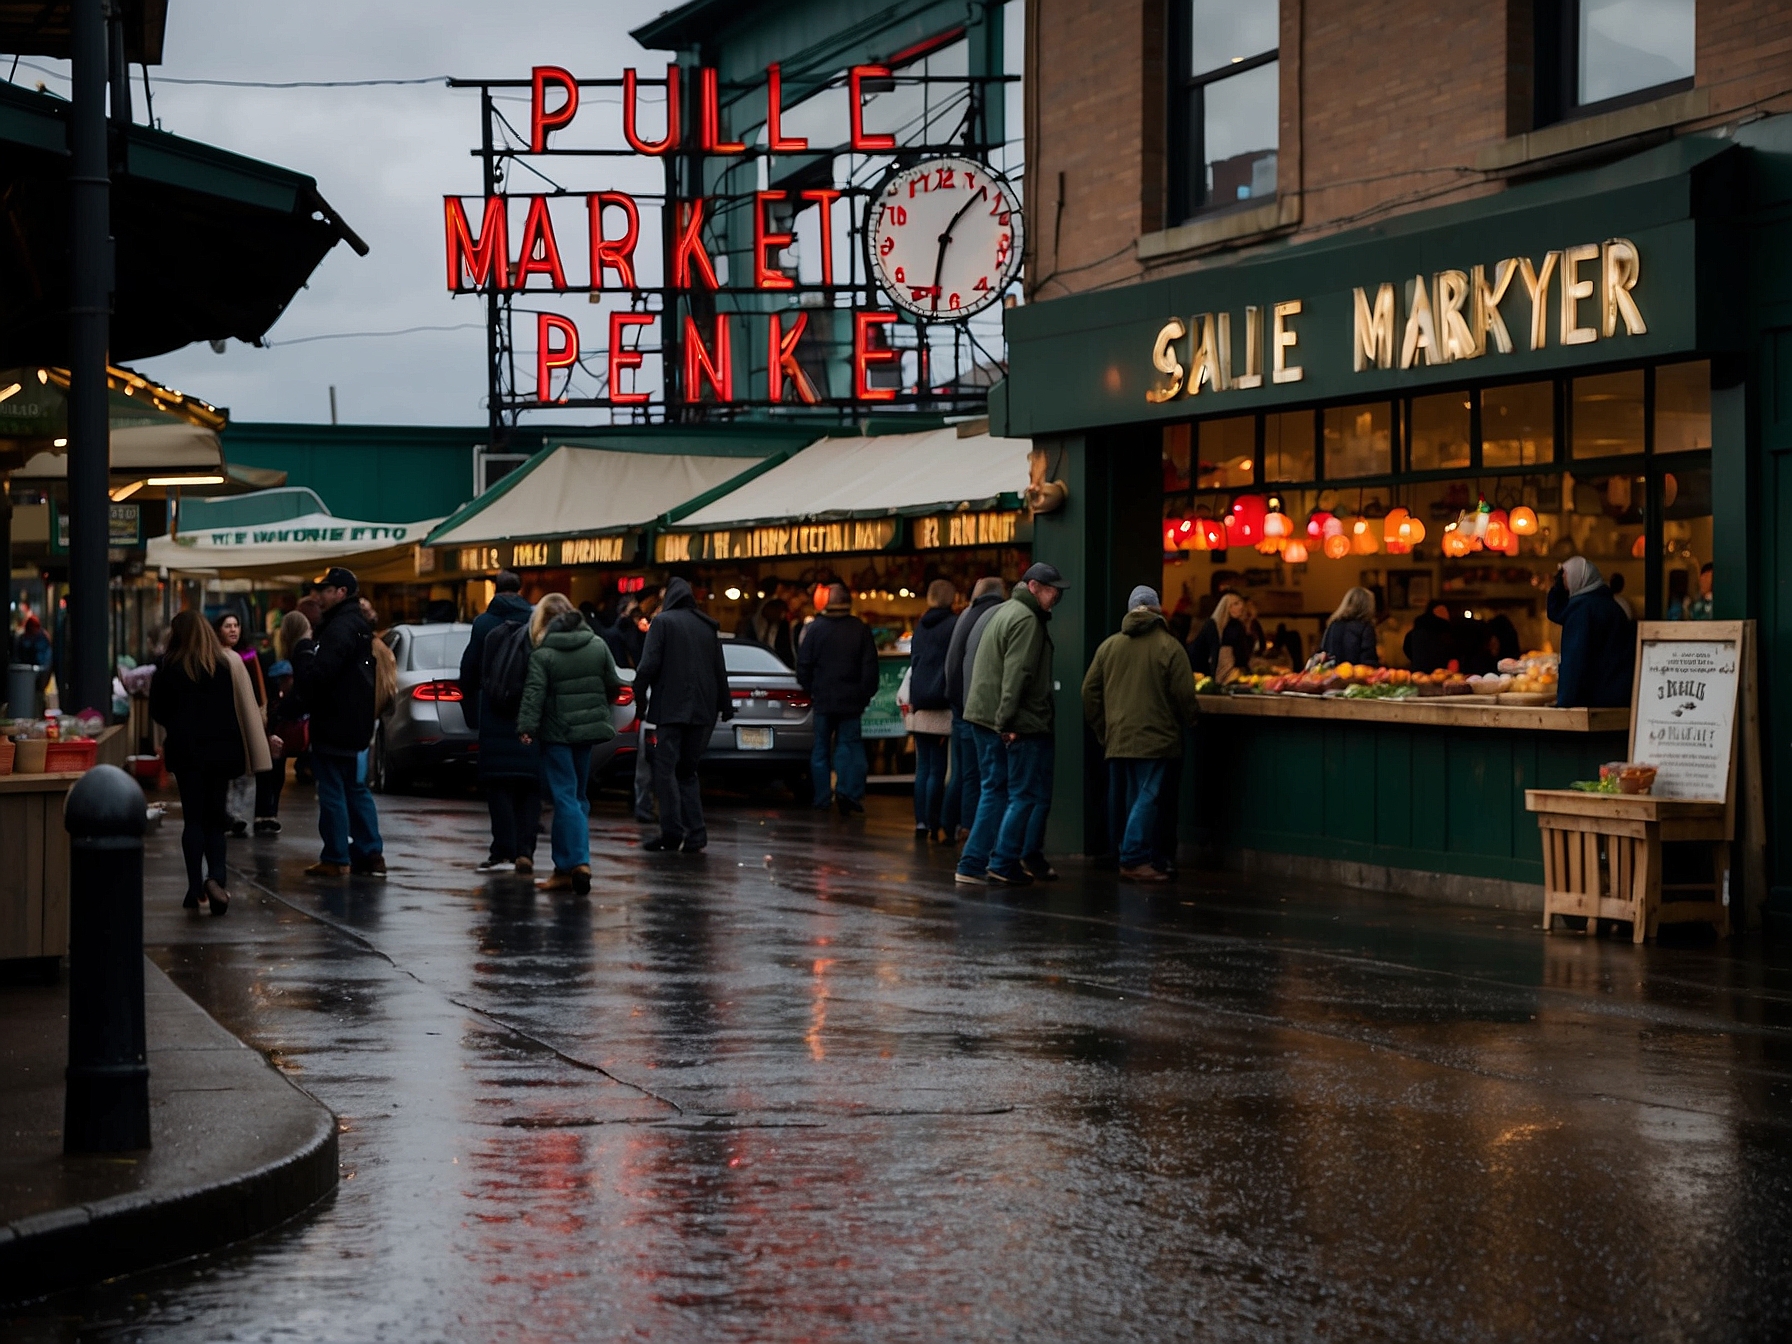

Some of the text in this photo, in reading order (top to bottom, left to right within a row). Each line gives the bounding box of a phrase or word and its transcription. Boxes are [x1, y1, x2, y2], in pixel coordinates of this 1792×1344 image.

[531, 62, 895, 155] PULLE
[444, 190, 841, 291] MARKET
[537, 311, 900, 404] PENKE
